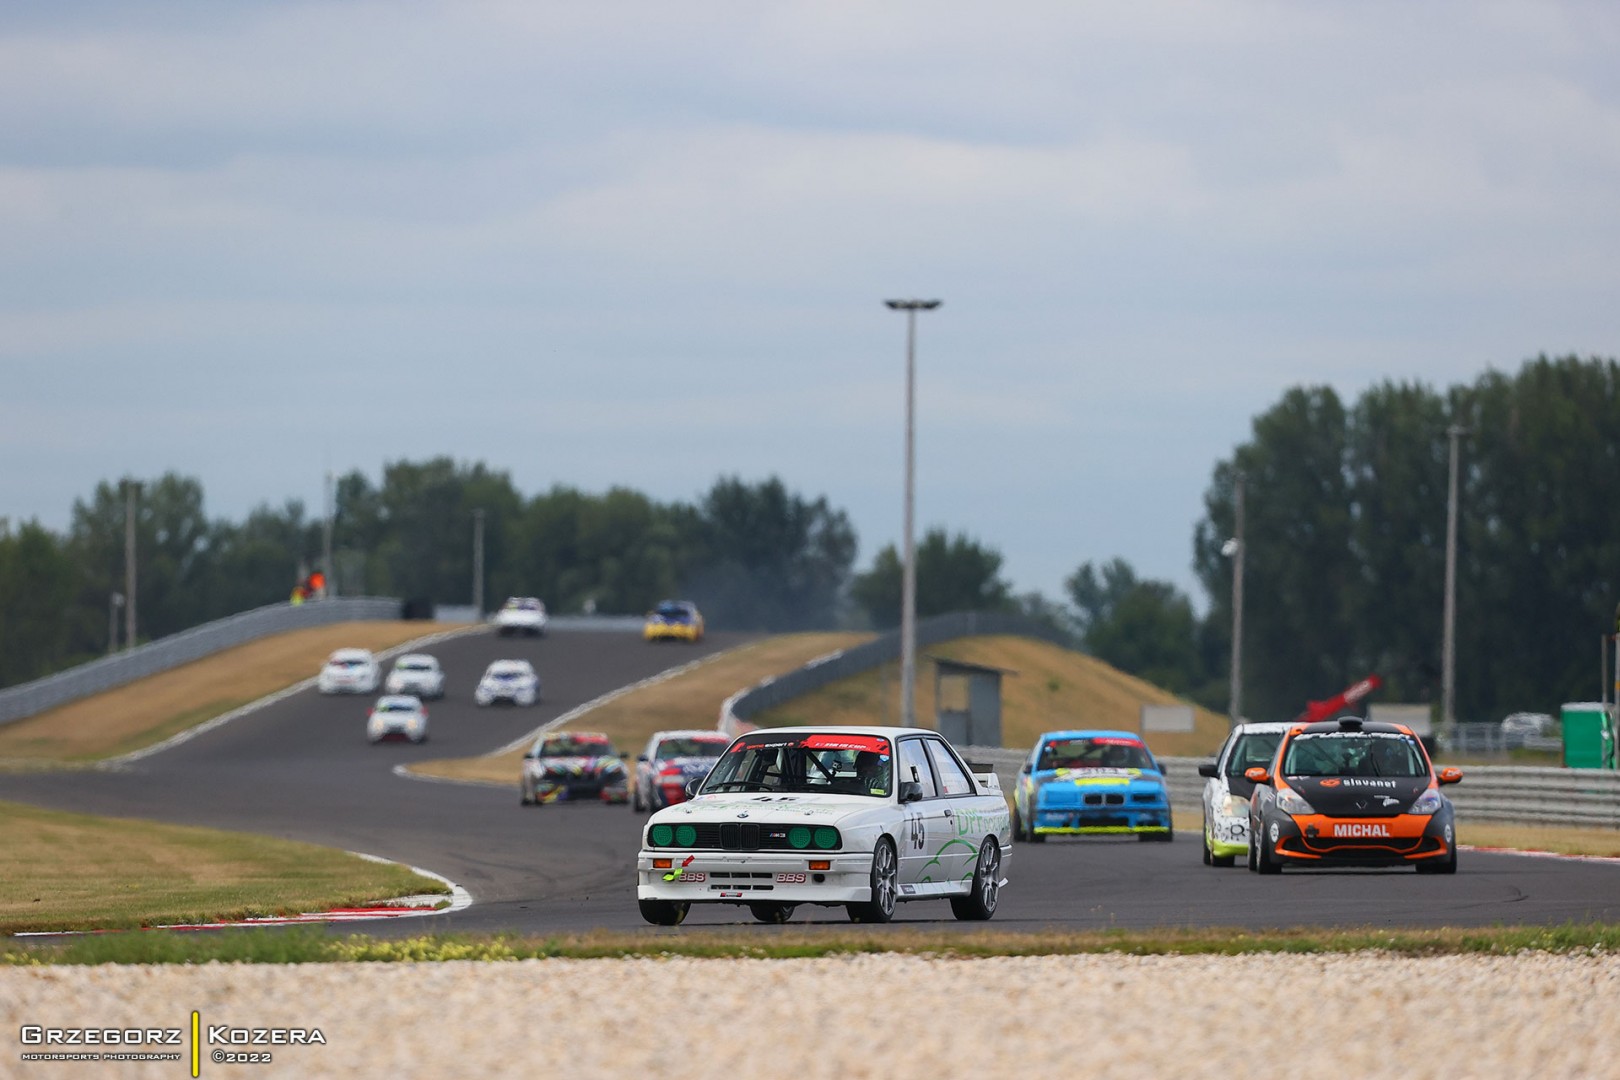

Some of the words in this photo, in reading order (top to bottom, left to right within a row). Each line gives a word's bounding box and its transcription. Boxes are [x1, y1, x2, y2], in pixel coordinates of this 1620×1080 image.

[910, 812, 925, 850] 45
[1334, 823, 1390, 838] MICHAL
[679, 872, 706, 882] BBS
[776, 873, 806, 883] BBS
